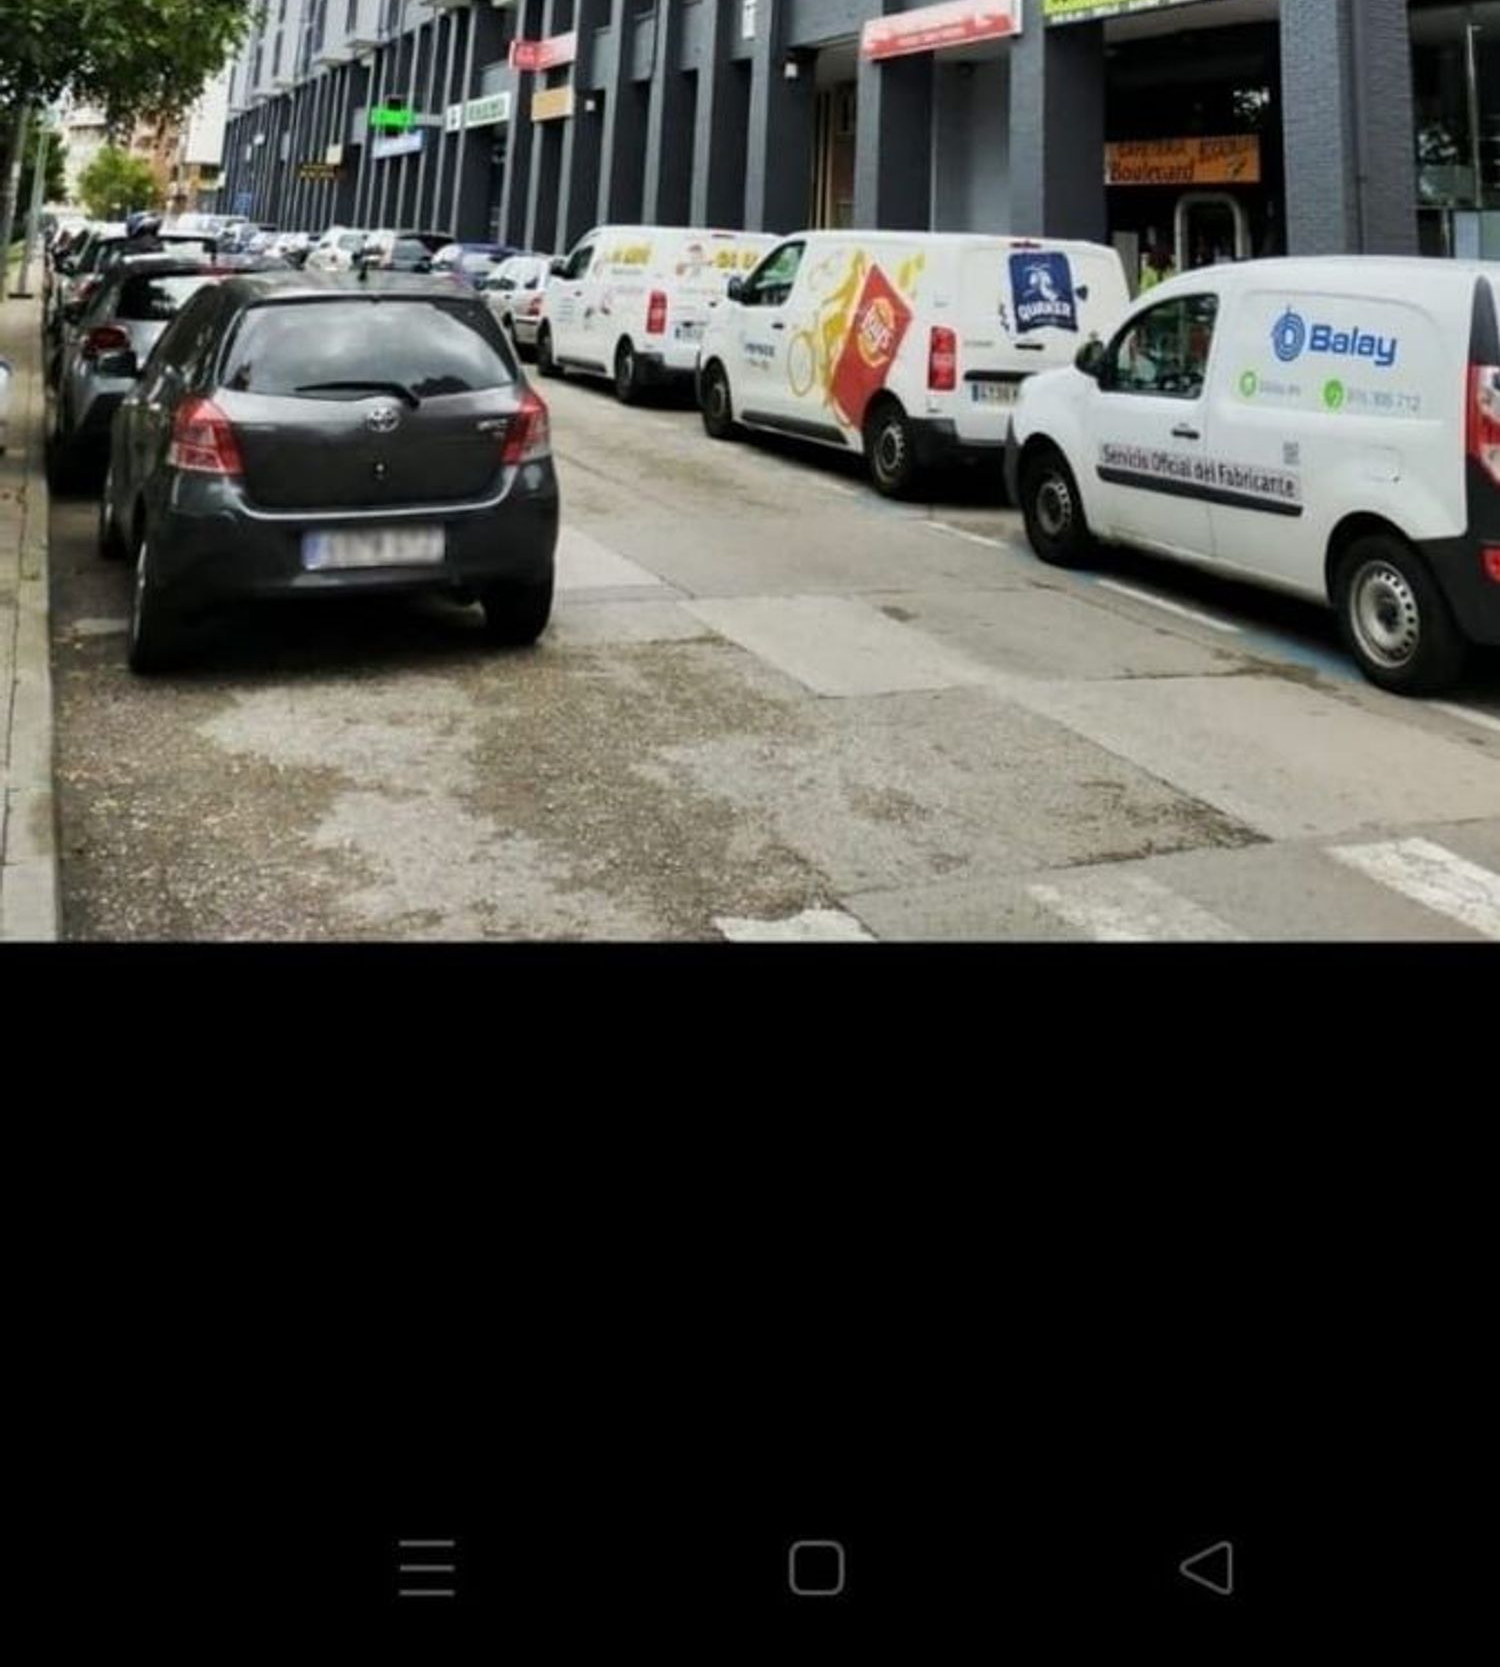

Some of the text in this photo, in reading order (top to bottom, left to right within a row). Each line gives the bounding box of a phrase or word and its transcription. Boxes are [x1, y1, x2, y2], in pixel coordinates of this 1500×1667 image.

[1018, 300, 1072, 322] QUAKER
[1309, 324, 1397, 366] Balay
[1103, 443, 1297, 498] Servicio Oficial del Fabricante
